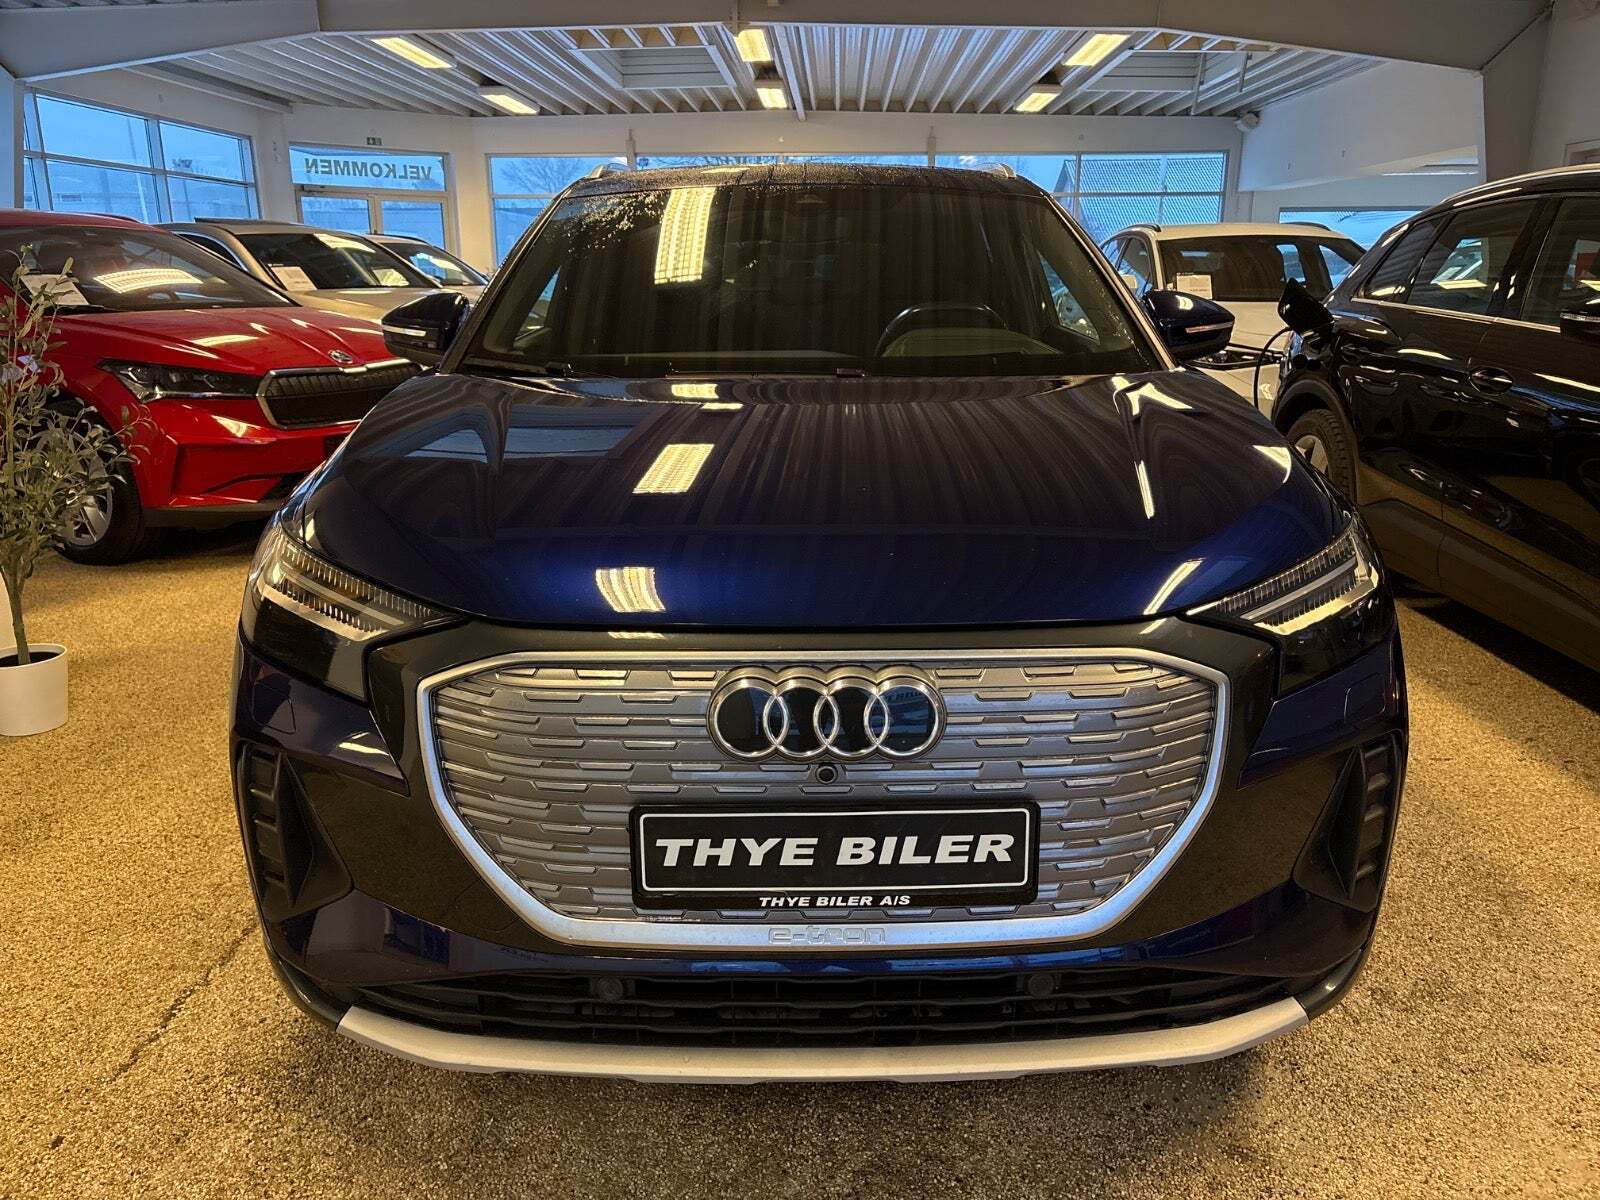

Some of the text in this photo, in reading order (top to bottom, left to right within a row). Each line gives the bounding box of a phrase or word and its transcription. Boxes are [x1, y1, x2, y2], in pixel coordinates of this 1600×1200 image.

[655, 834, 1015, 866] THYE BILER
[759, 895, 911, 907] THYE BILER A/S
[768, 925, 886, 945] e-tron
